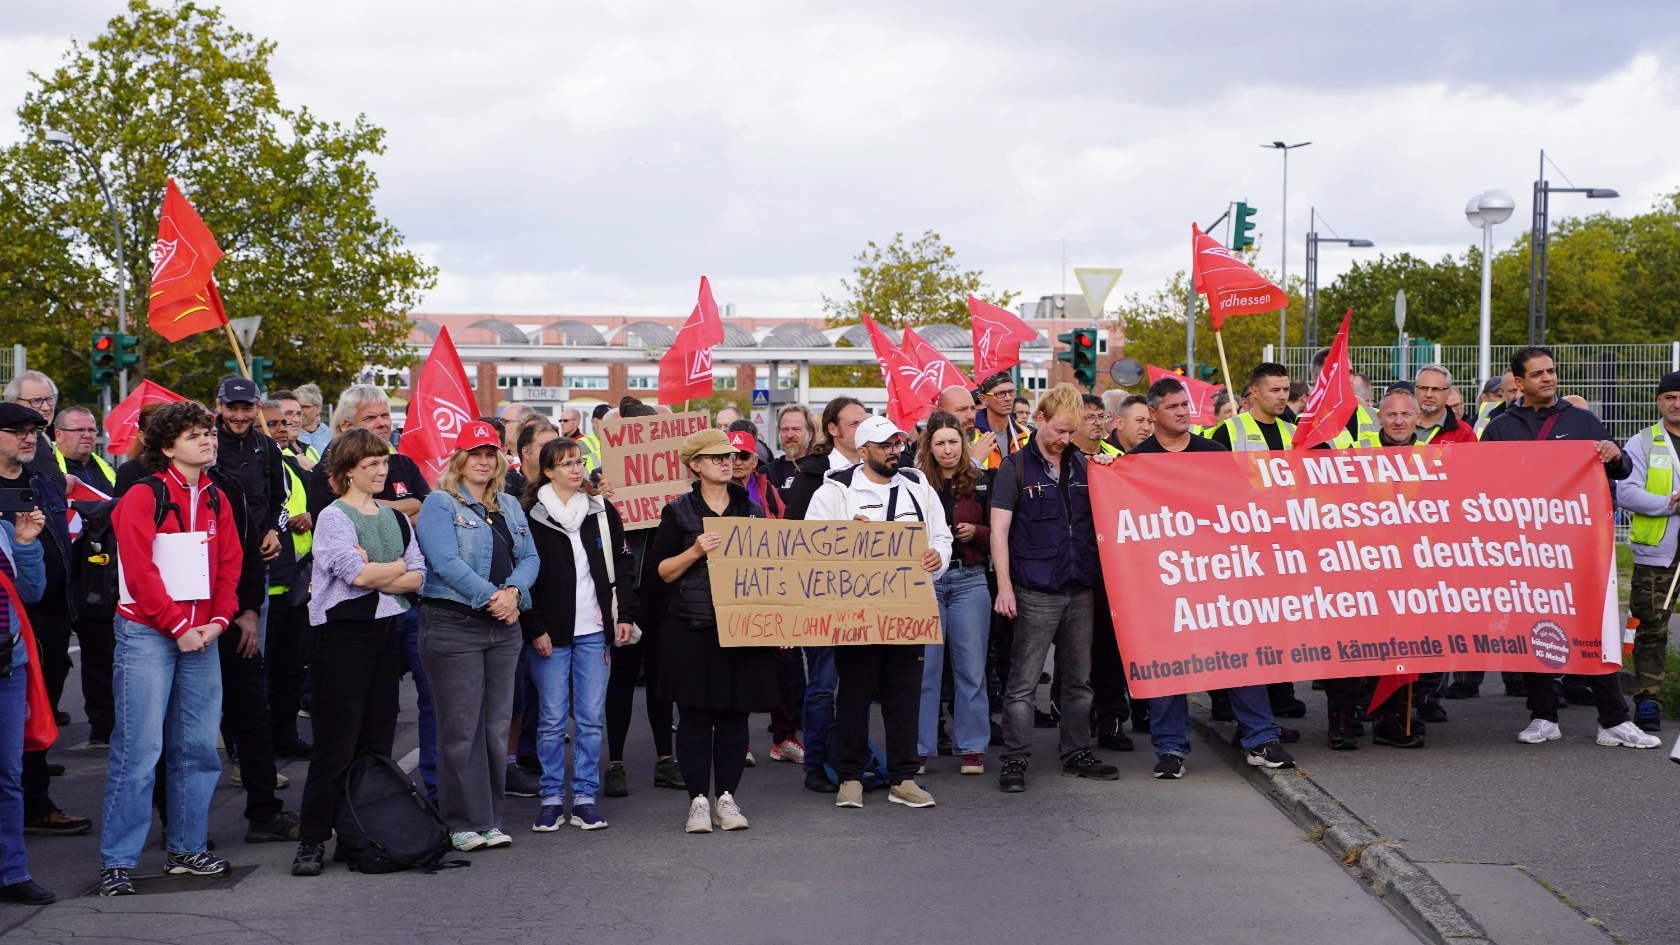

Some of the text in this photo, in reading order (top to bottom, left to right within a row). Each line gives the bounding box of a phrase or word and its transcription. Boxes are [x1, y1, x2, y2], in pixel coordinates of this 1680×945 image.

[527, 388, 556, 398] TOR 2
[603, 416, 708, 448] WIR ZAHLEN
[624, 450, 693, 486] NICH
[1257, 453, 1448, 487] IG METALL:
[613, 496, 662, 523] EURE
[1116, 492, 1592, 544] Auto-Job-Massaker stoppen!
[724, 525, 923, 558] MANAGEMENT
[1158, 534, 1573, 586] Streik in allen deutschen
[1173, 580, 1576, 633] Autowerken vorbereiten!
[728, 611, 786, 639] UNSER
[791, 614, 833, 637] LOHN
[876, 615, 940, 641] VERZOCKT
[1532, 622, 1567, 642] Autoarbeiter
[1129, 634, 1529, 681] Autoarbeiter für eine kämpfende IG Metall
[1531, 637, 1569, 653] kämpfende
[1536, 649, 1566, 663] IG Metall
[1572, 637, 1602, 647] Mercede
[1580, 650, 1600, 658] Werk
